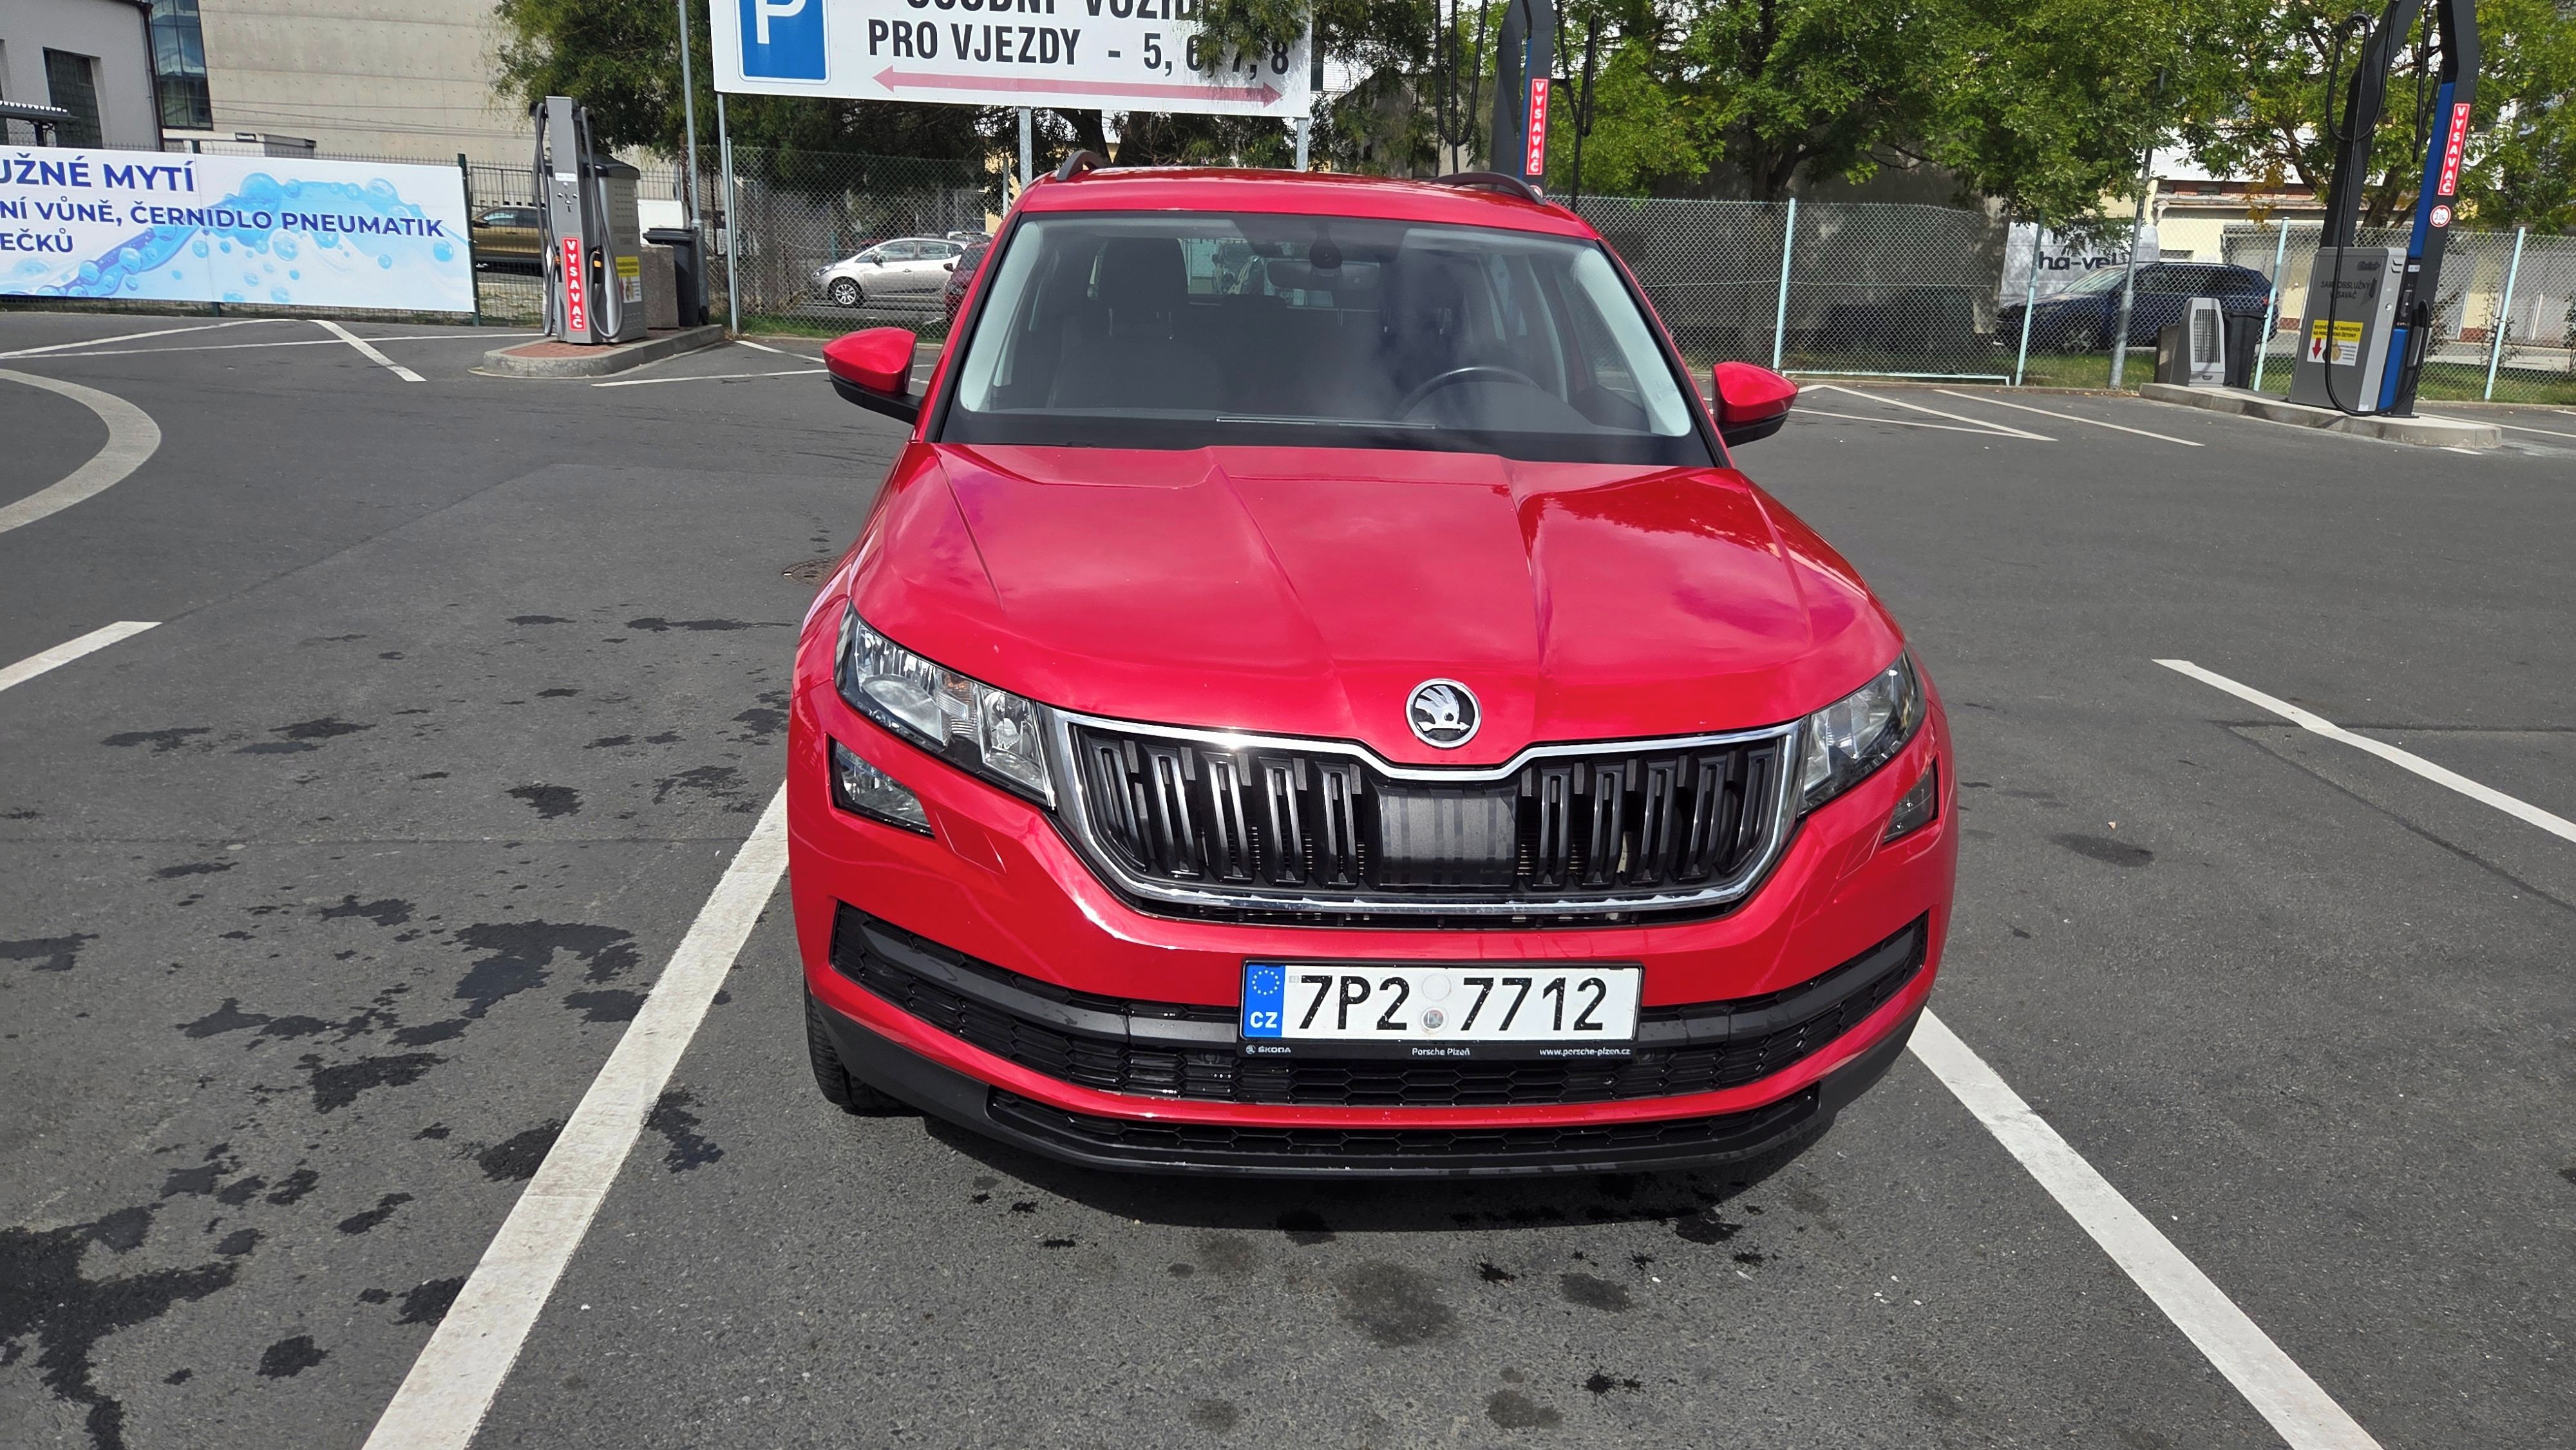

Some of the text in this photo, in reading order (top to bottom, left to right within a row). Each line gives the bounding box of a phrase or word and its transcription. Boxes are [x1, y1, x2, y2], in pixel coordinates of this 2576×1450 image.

[868, 19, 938, 59] PRO
[951, 23, 1081, 65] VJEZDY
[1144, 33, 1172, 77] 5,
[1271, 39, 1289, 75] 8
[1530, 82, 1545, 172] VYSAVAČ
[2442, 106, 2466, 193] VYSAVAČ
[103, 160, 194, 191] MYTÍ
[0, 196, 444, 237] NÍ VŮNĚ, ČERNIDLO PNEUMATIK
[0, 228, 73, 253] EČKŮ
[567, 240, 583, 328] VYSAVAČ
[1250, 1012, 1278, 1028] CZ
[1299, 975, 1607, 1031] 7P2 7712
[1412, 1048, 1470, 1056] Porsche Plzeň
[1539, 1048, 1631, 1057] www.porsche-plzen.cz
